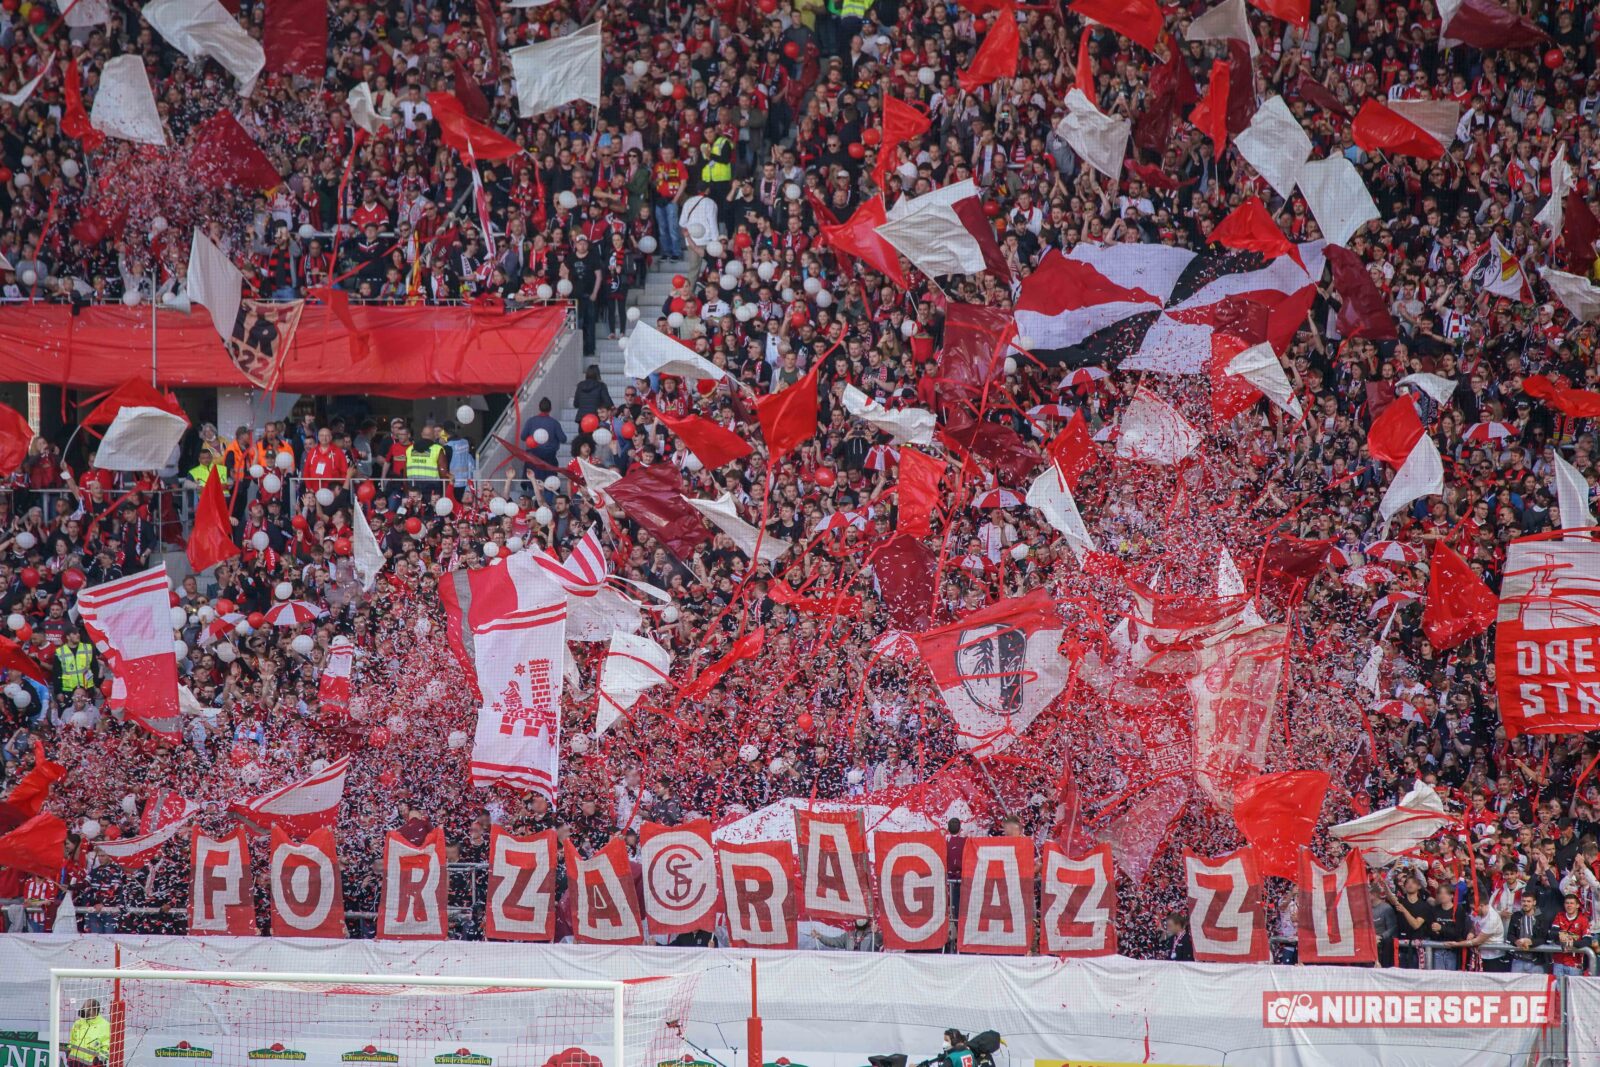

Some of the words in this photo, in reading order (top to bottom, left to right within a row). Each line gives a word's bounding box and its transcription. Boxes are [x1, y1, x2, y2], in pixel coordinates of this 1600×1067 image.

[1516, 637, 1600, 676] DRE
[193, 836, 641, 941] FORZA
[718, 821, 1356, 957] RAGAZZI
